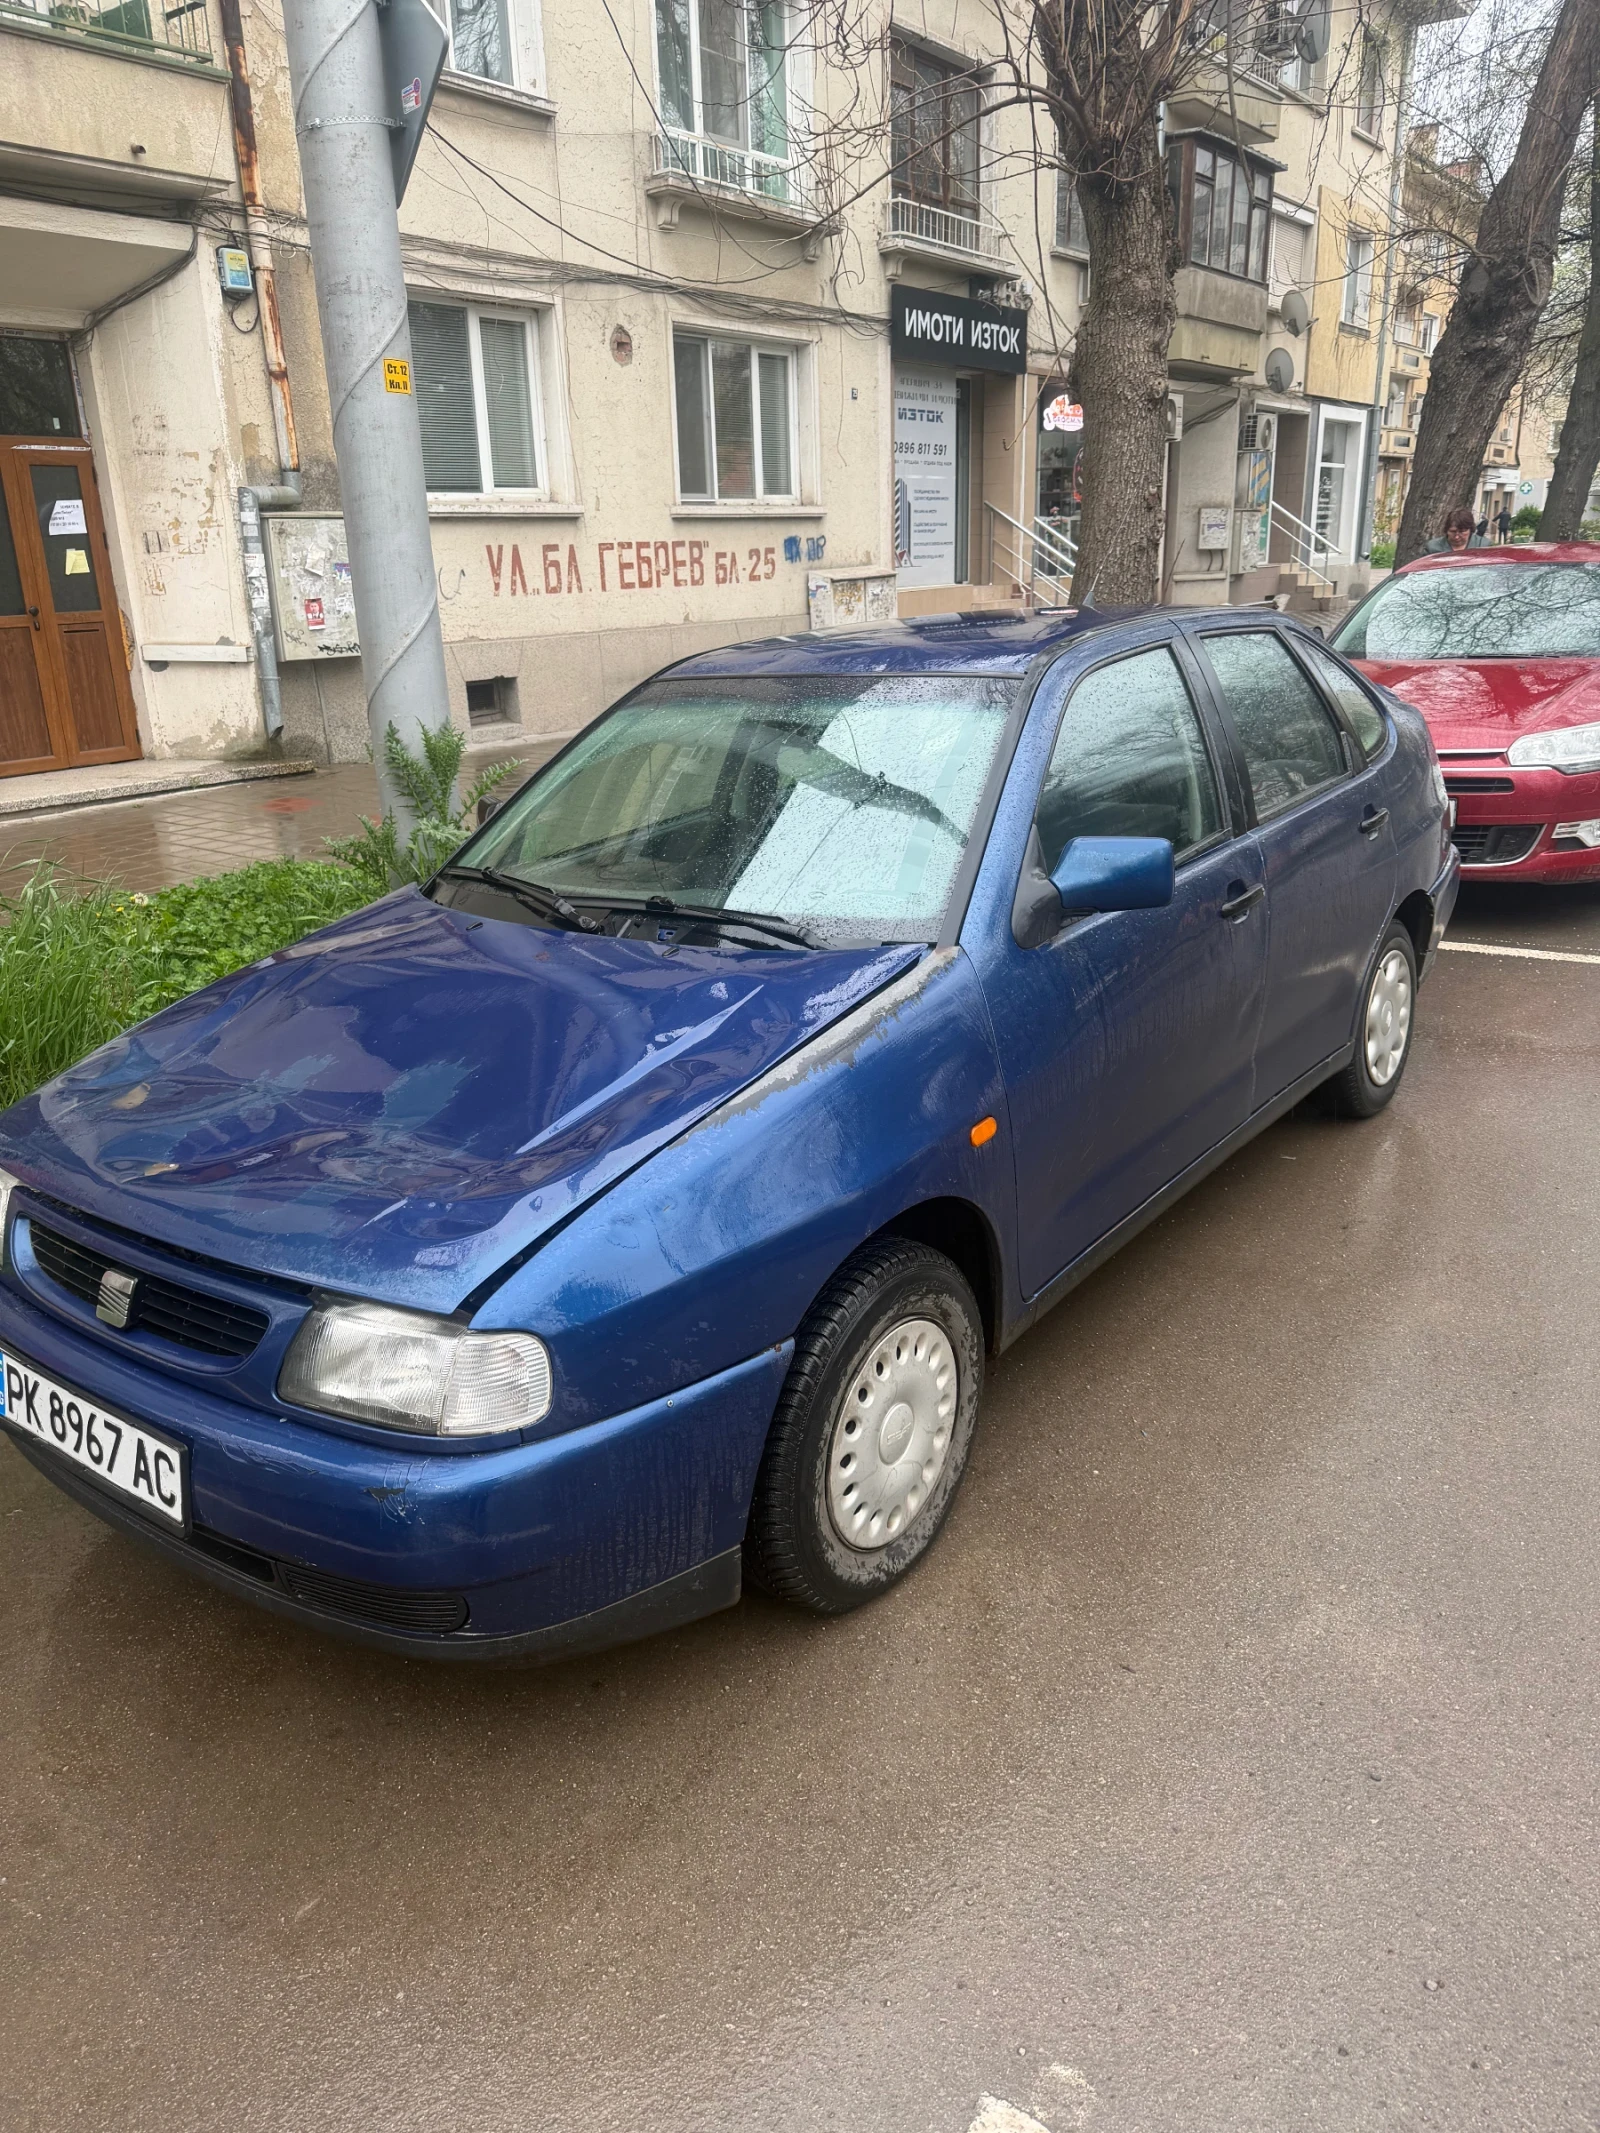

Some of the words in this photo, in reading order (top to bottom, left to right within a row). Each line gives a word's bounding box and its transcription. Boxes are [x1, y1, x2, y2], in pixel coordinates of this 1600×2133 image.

[905, 307, 964, 345] ИМОТИ
[971, 319, 1020, 355] ИЗТОК
[387, 363, 400, 375] Ст.
[400, 365, 408, 376] 12
[898, 407, 944, 423] ИЗТОК
[918, 442, 931, 455] 811
[933, 444, 947, 456] 591
[6, 1363, 44, 1432] PK
[50, 1390, 122, 1473] 8967
[133, 1437, 176, 1508] AC
